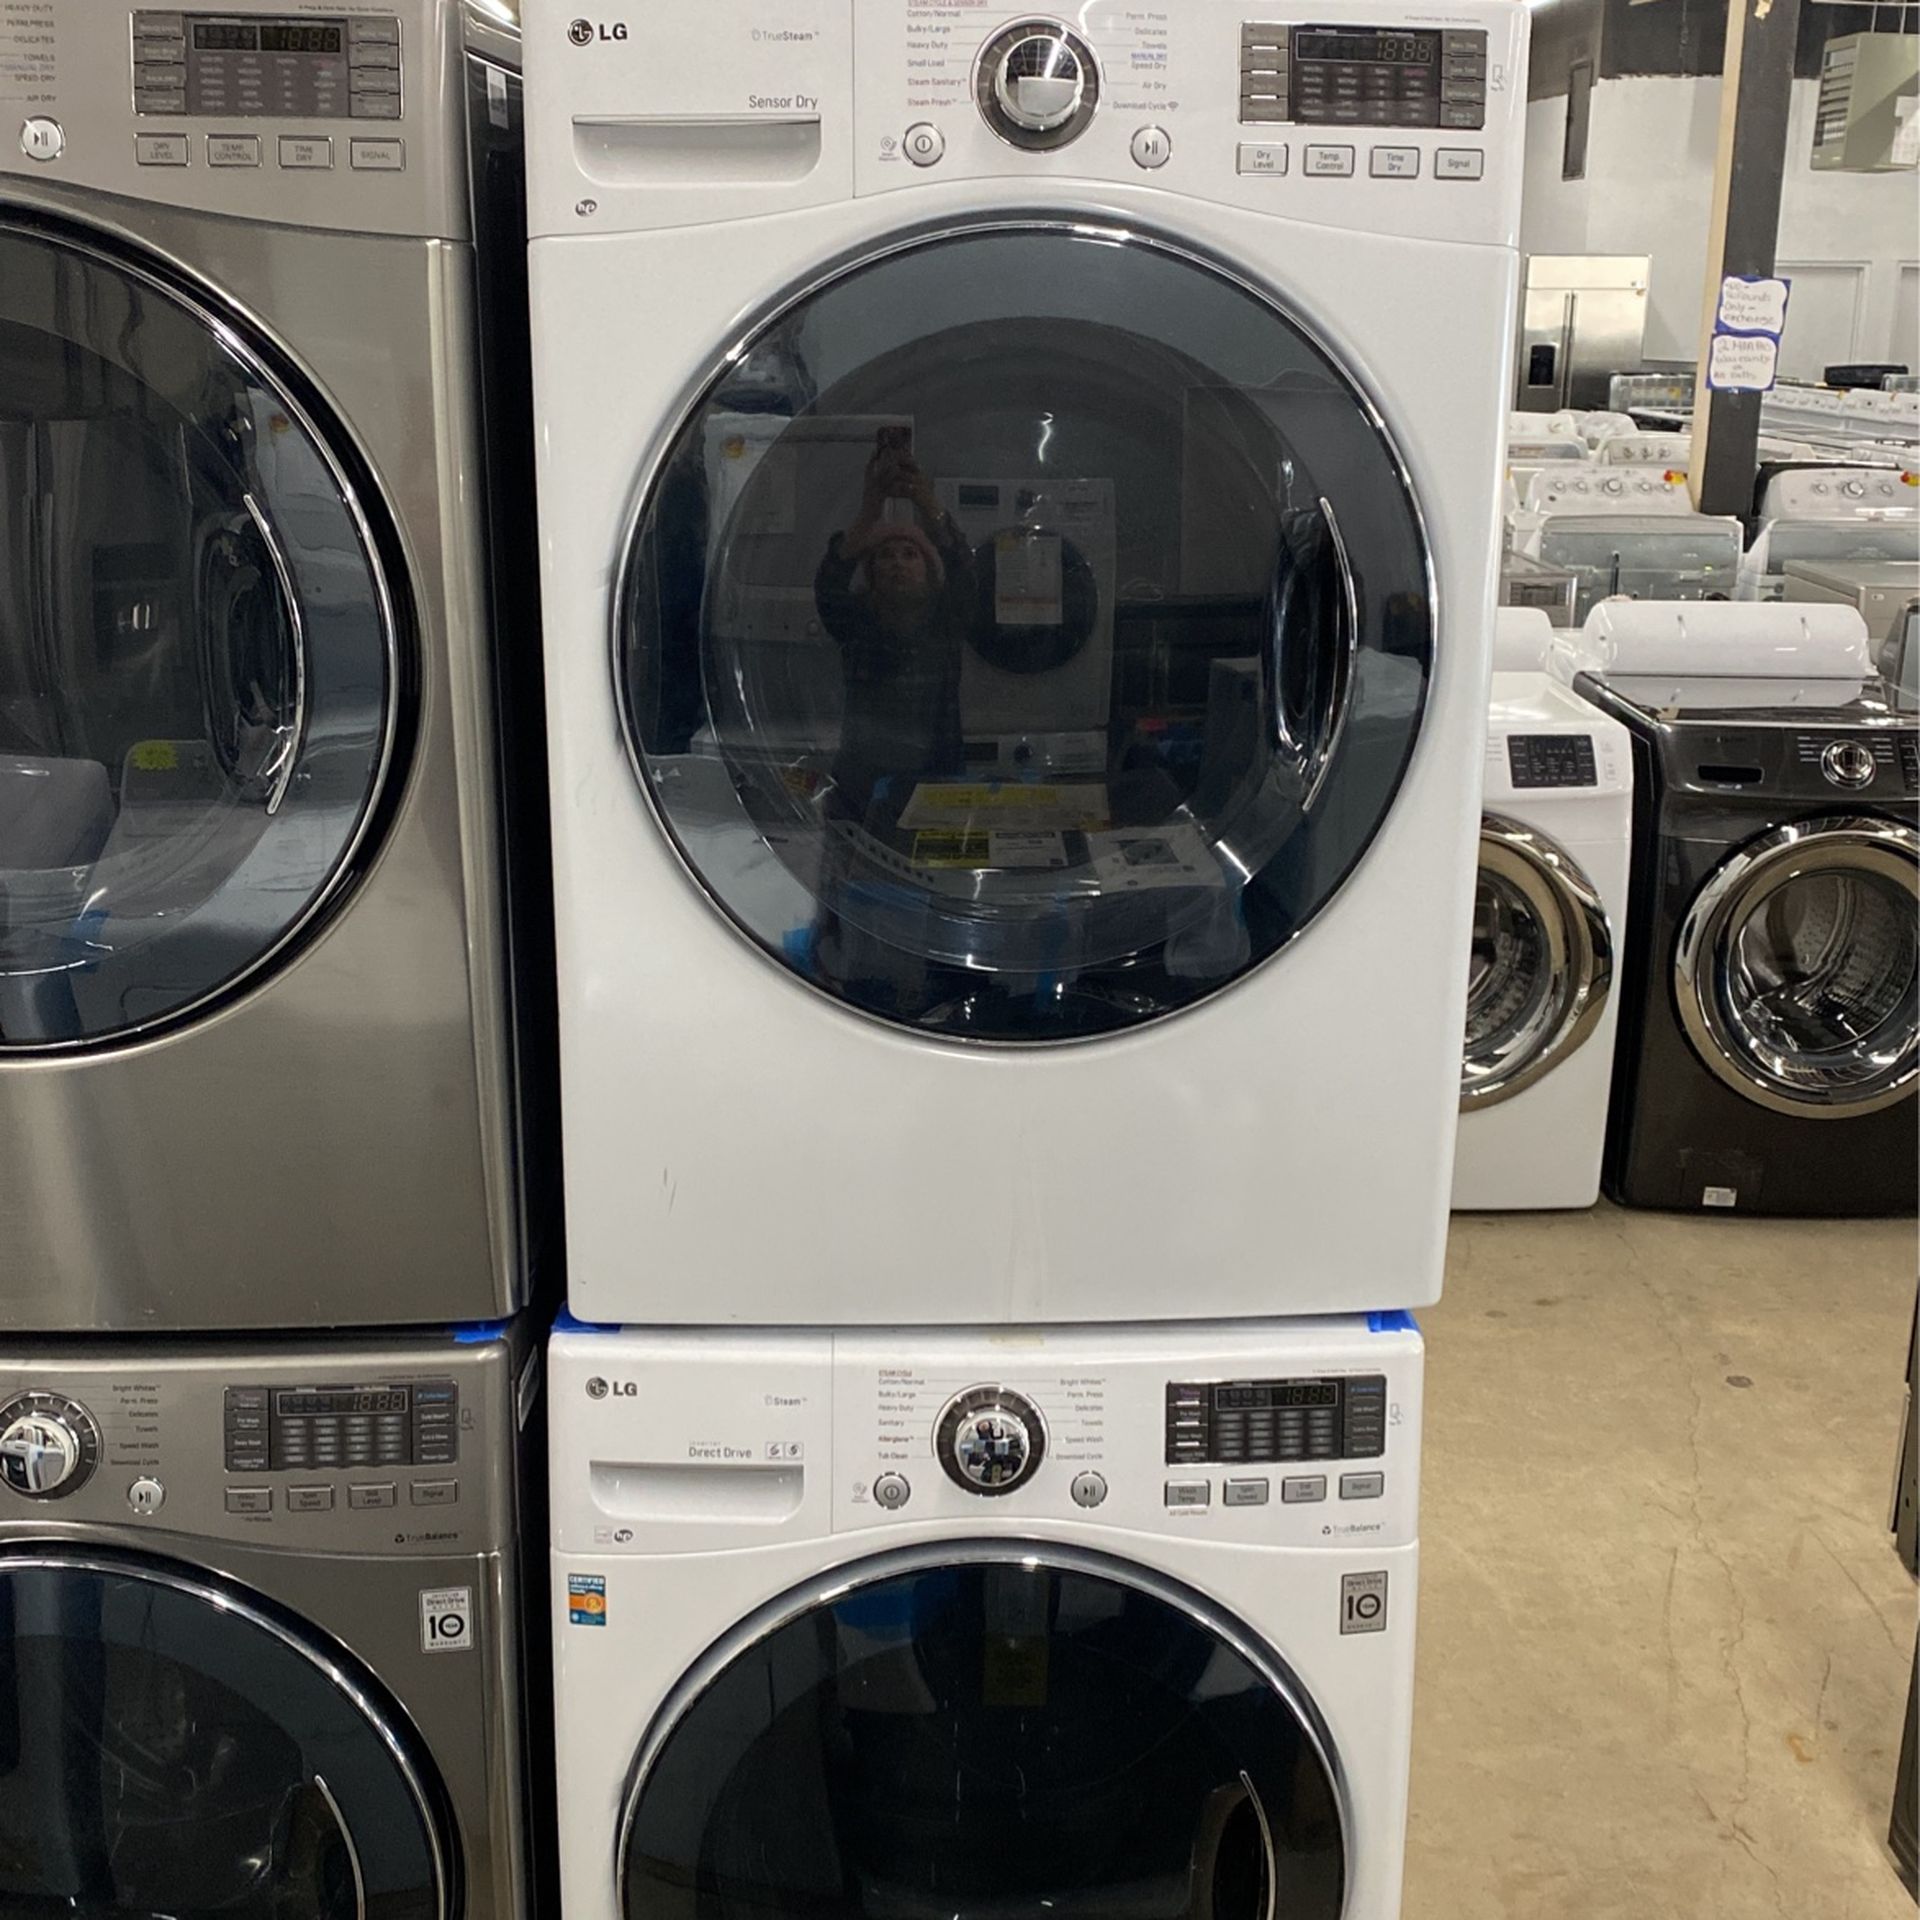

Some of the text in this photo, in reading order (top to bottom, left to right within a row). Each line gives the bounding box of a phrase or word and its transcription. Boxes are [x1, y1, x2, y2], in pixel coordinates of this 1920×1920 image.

[599, 23, 628, 41] LG
[907, 24, 951, 34] Bulky/Large
[907, 41, 948, 49] Heavy Duty
[907, 59, 945, 67] Small Load
[907, 78, 930, 86] Steam
[1154, 81, 1167, 91] Dry
[748, 94, 818, 111] Sensor Dry
[907, 98, 930, 106] Steam
[1256, 150, 1271, 160] Dry
[1253, 160, 1274, 169] Level
[1316, 161, 1344, 170] Control
[1447, 157, 1471, 168] Signal
[613, 1382, 638, 1396] LG
[689, 1446, 752, 1458] Direct Drive
[1347, 1594, 1382, 1620] 10
[429, 1614, 465, 1639] 10
